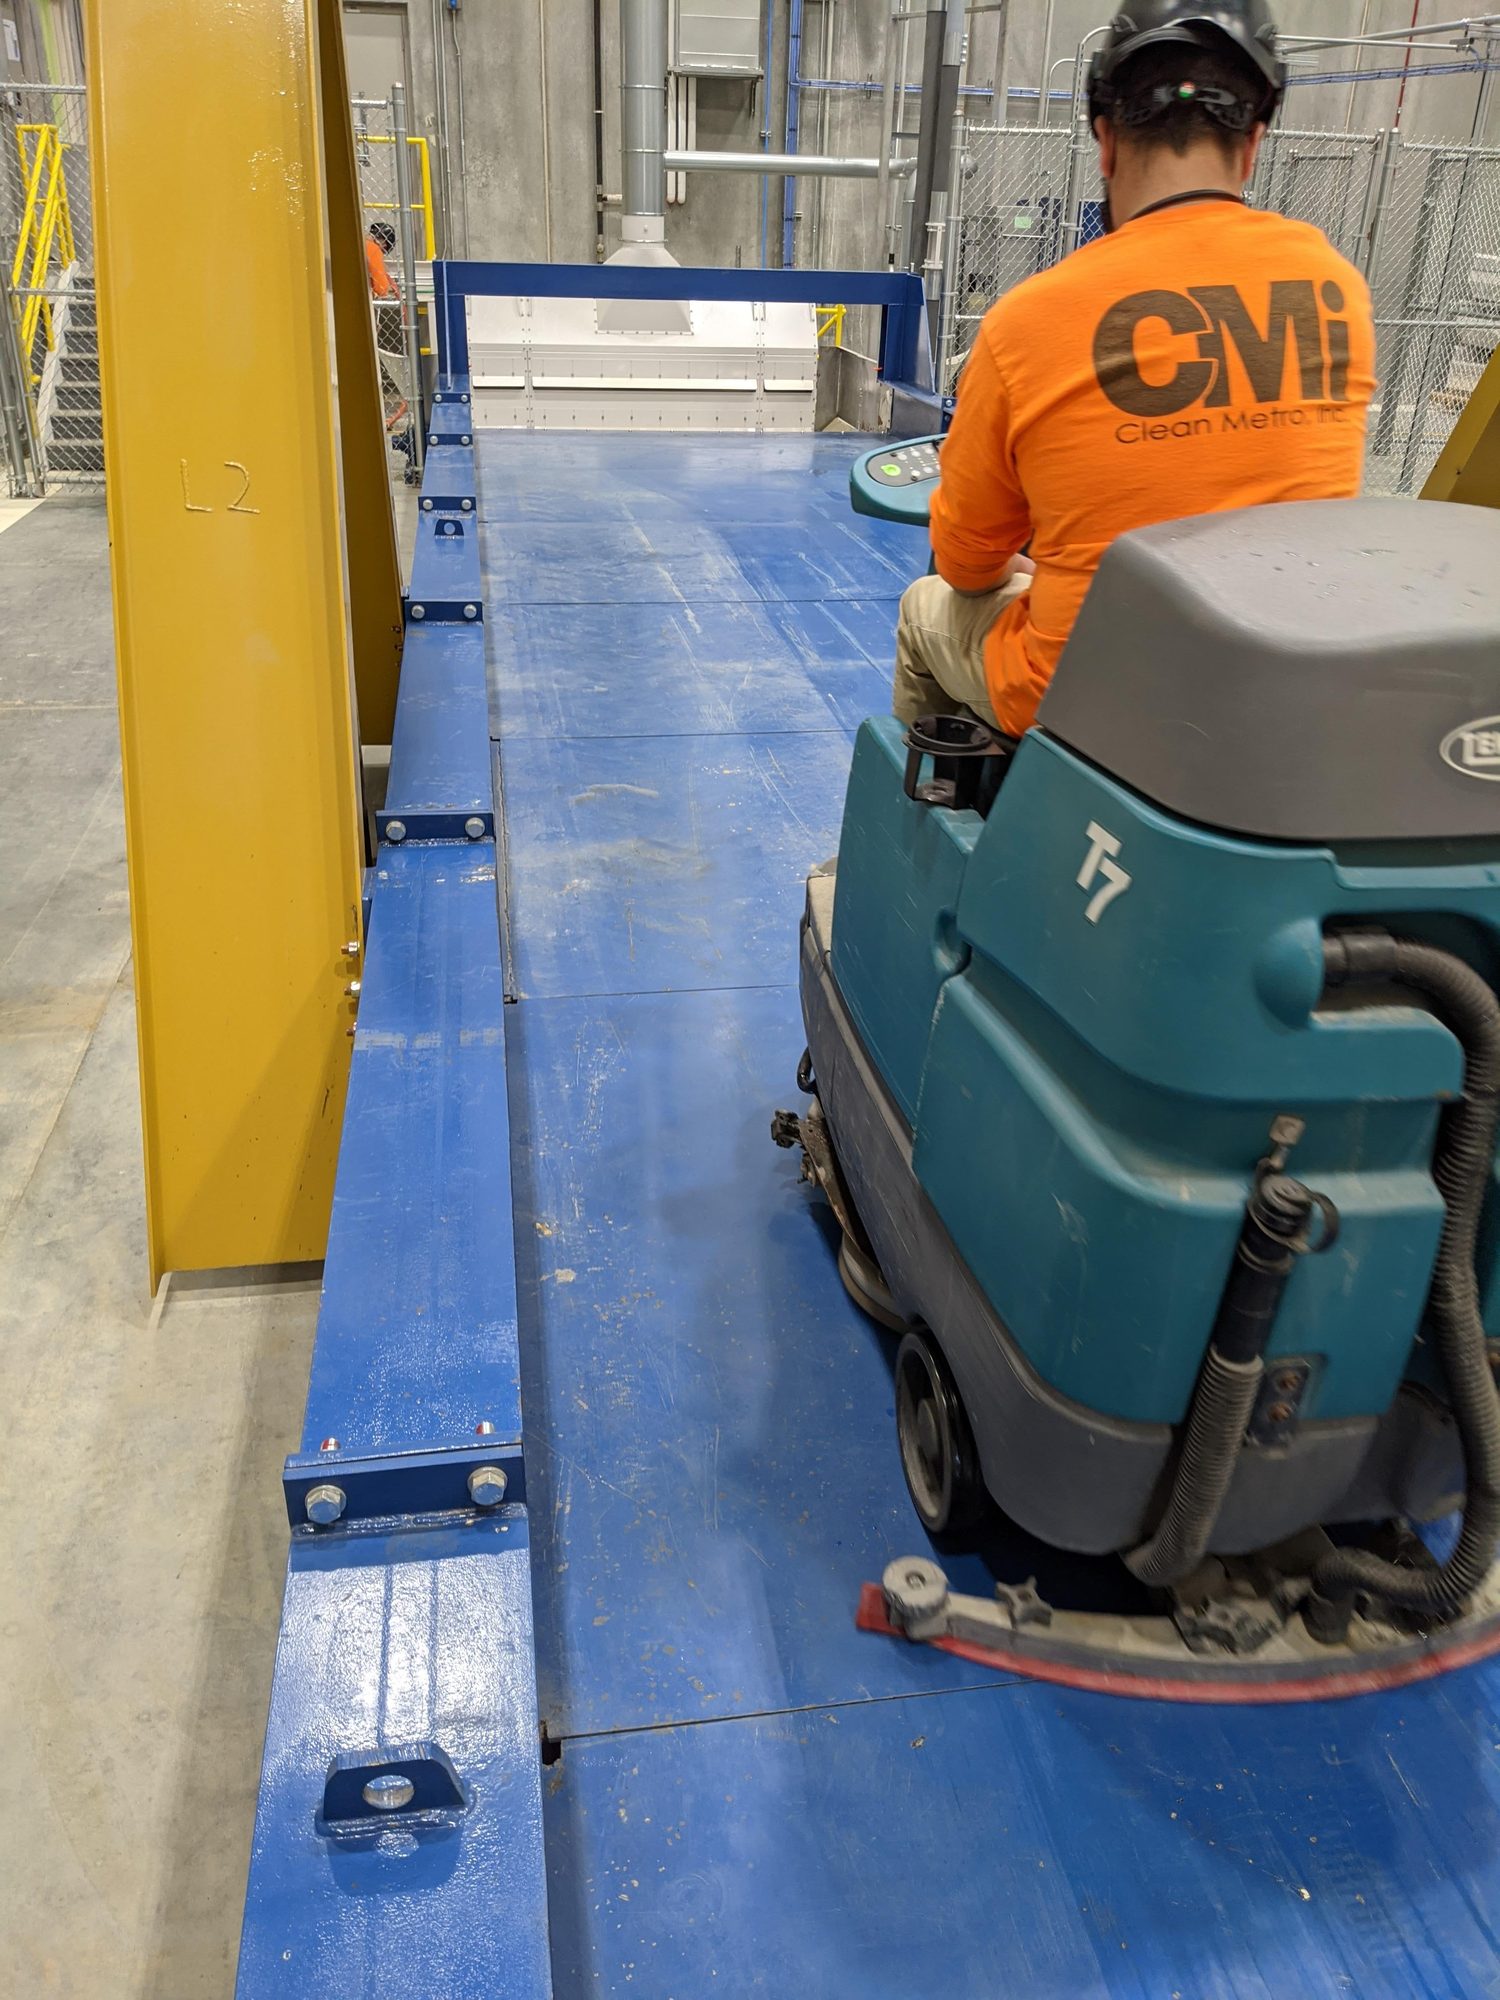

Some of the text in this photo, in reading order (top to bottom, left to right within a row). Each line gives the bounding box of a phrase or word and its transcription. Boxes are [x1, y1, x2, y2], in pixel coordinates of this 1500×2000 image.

[1092, 280, 1350, 418] CMi
[1115, 417, 1212, 444] Clean
[1076, 820, 1132, 924] T7
